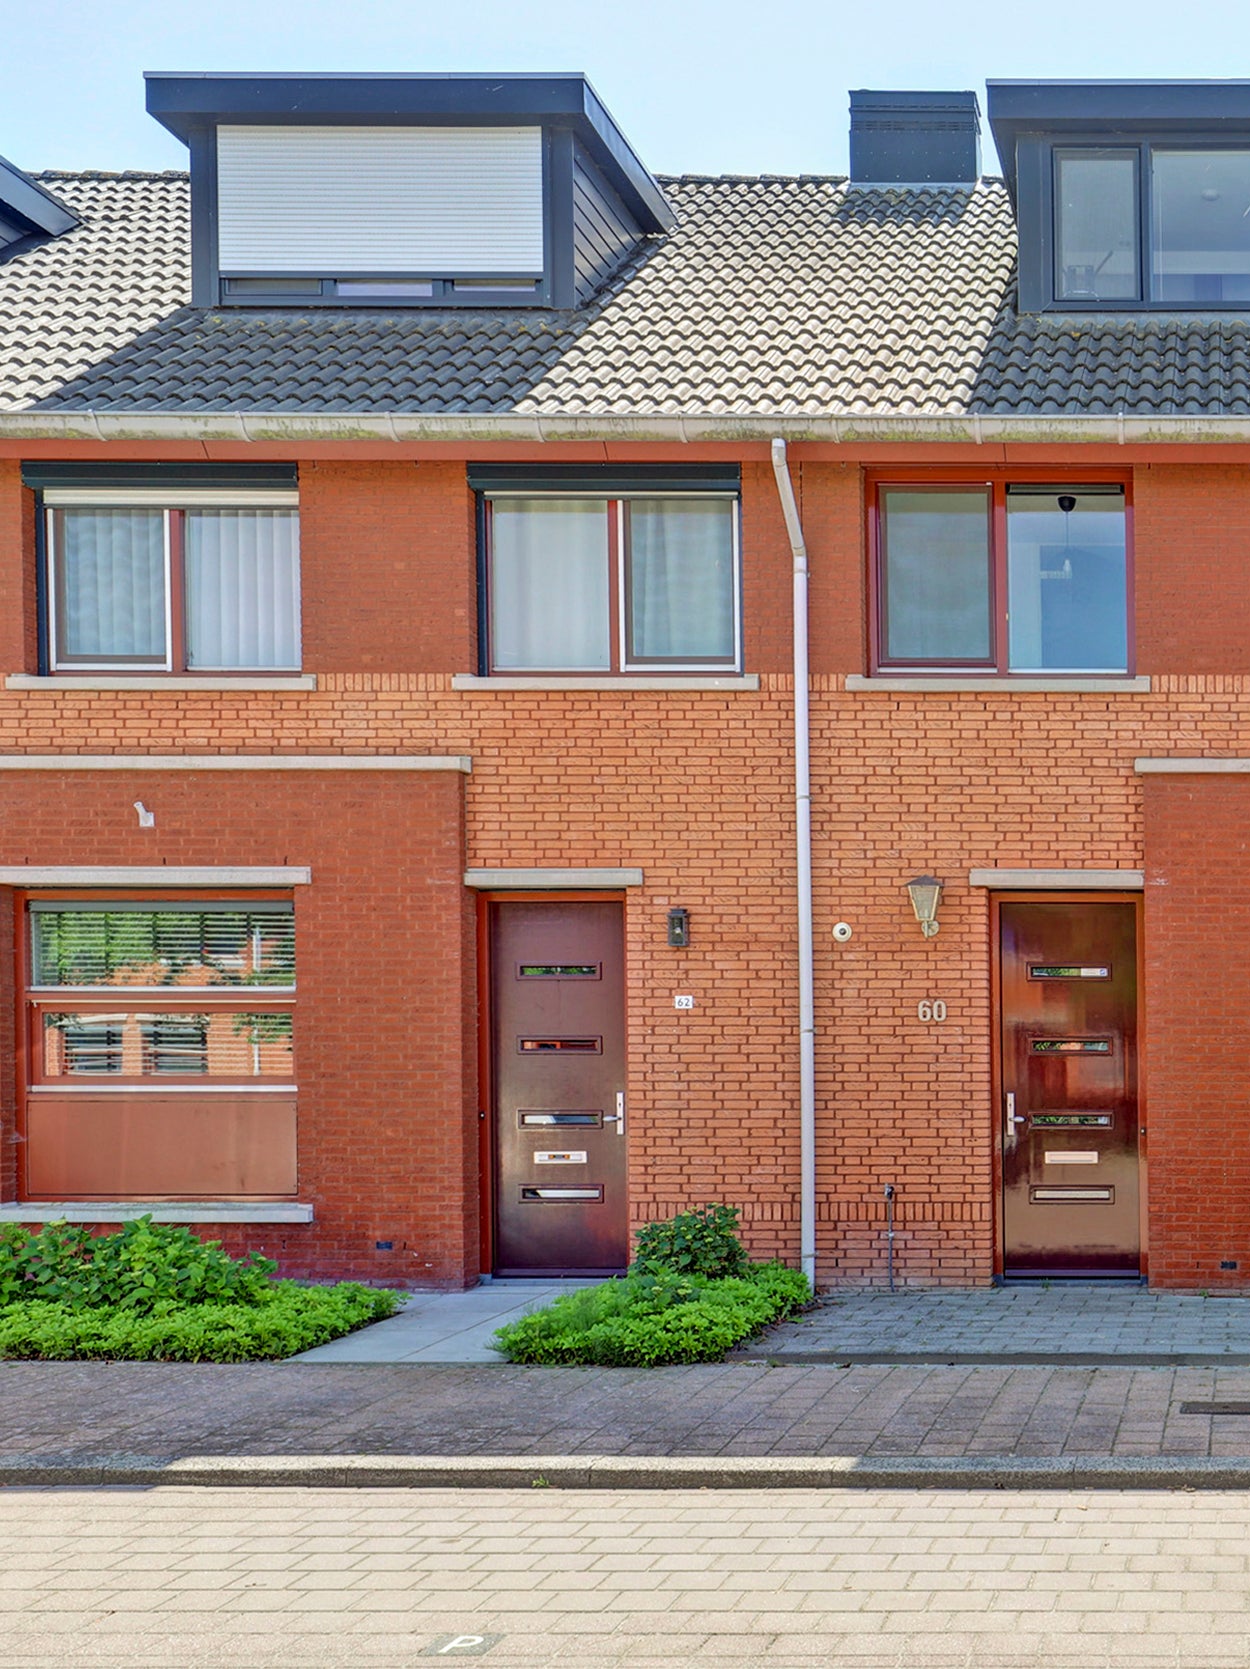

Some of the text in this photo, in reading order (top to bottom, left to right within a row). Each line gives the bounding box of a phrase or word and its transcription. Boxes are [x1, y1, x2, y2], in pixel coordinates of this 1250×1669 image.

[677, 997, 691, 1007] 62
[918, 1000, 947, 1022] 60
[438, 1635, 484, 1654] P
